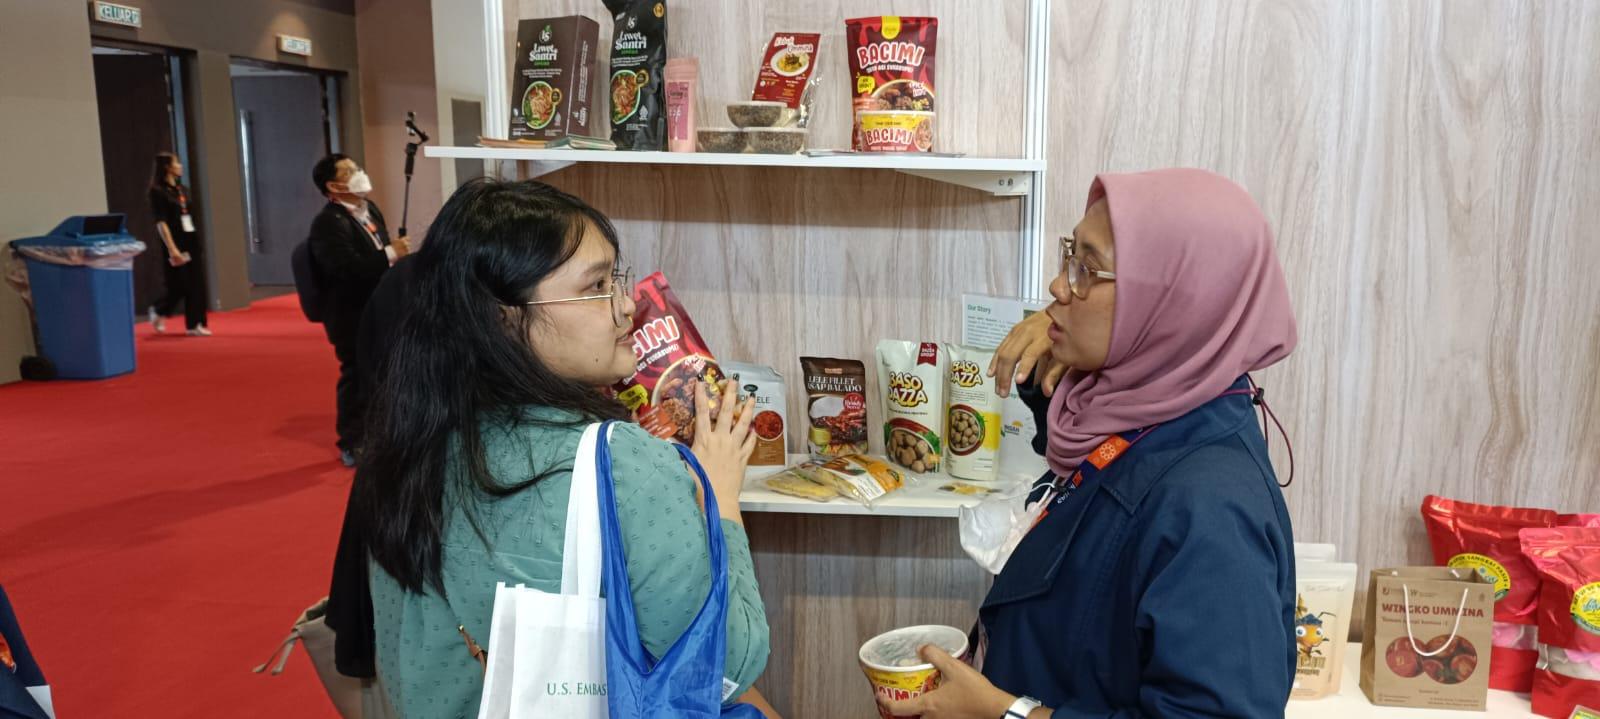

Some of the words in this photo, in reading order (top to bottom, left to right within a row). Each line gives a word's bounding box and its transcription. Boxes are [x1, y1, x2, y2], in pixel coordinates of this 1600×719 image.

[615, 35, 647, 50] Santri
[529, 48, 558, 61] Santri
[857, 41, 925, 69] BACIMI
[866, 128, 912, 145] BACIMI
[977, 306, 991, 314] Story
[952, 360, 979, 375] BASO
[808, 376, 828, 384] LELE
[829, 376, 855, 385] FILLET
[889, 370, 923, 390] BASO
[827, 384, 862, 392] BALADO
[1382, 603, 1430, 615] WINGKO
[1432, 606, 1484, 617] UMMINA
[547, 682, 572, 696] U.S.
[577, 682, 607, 696] EMBAS
